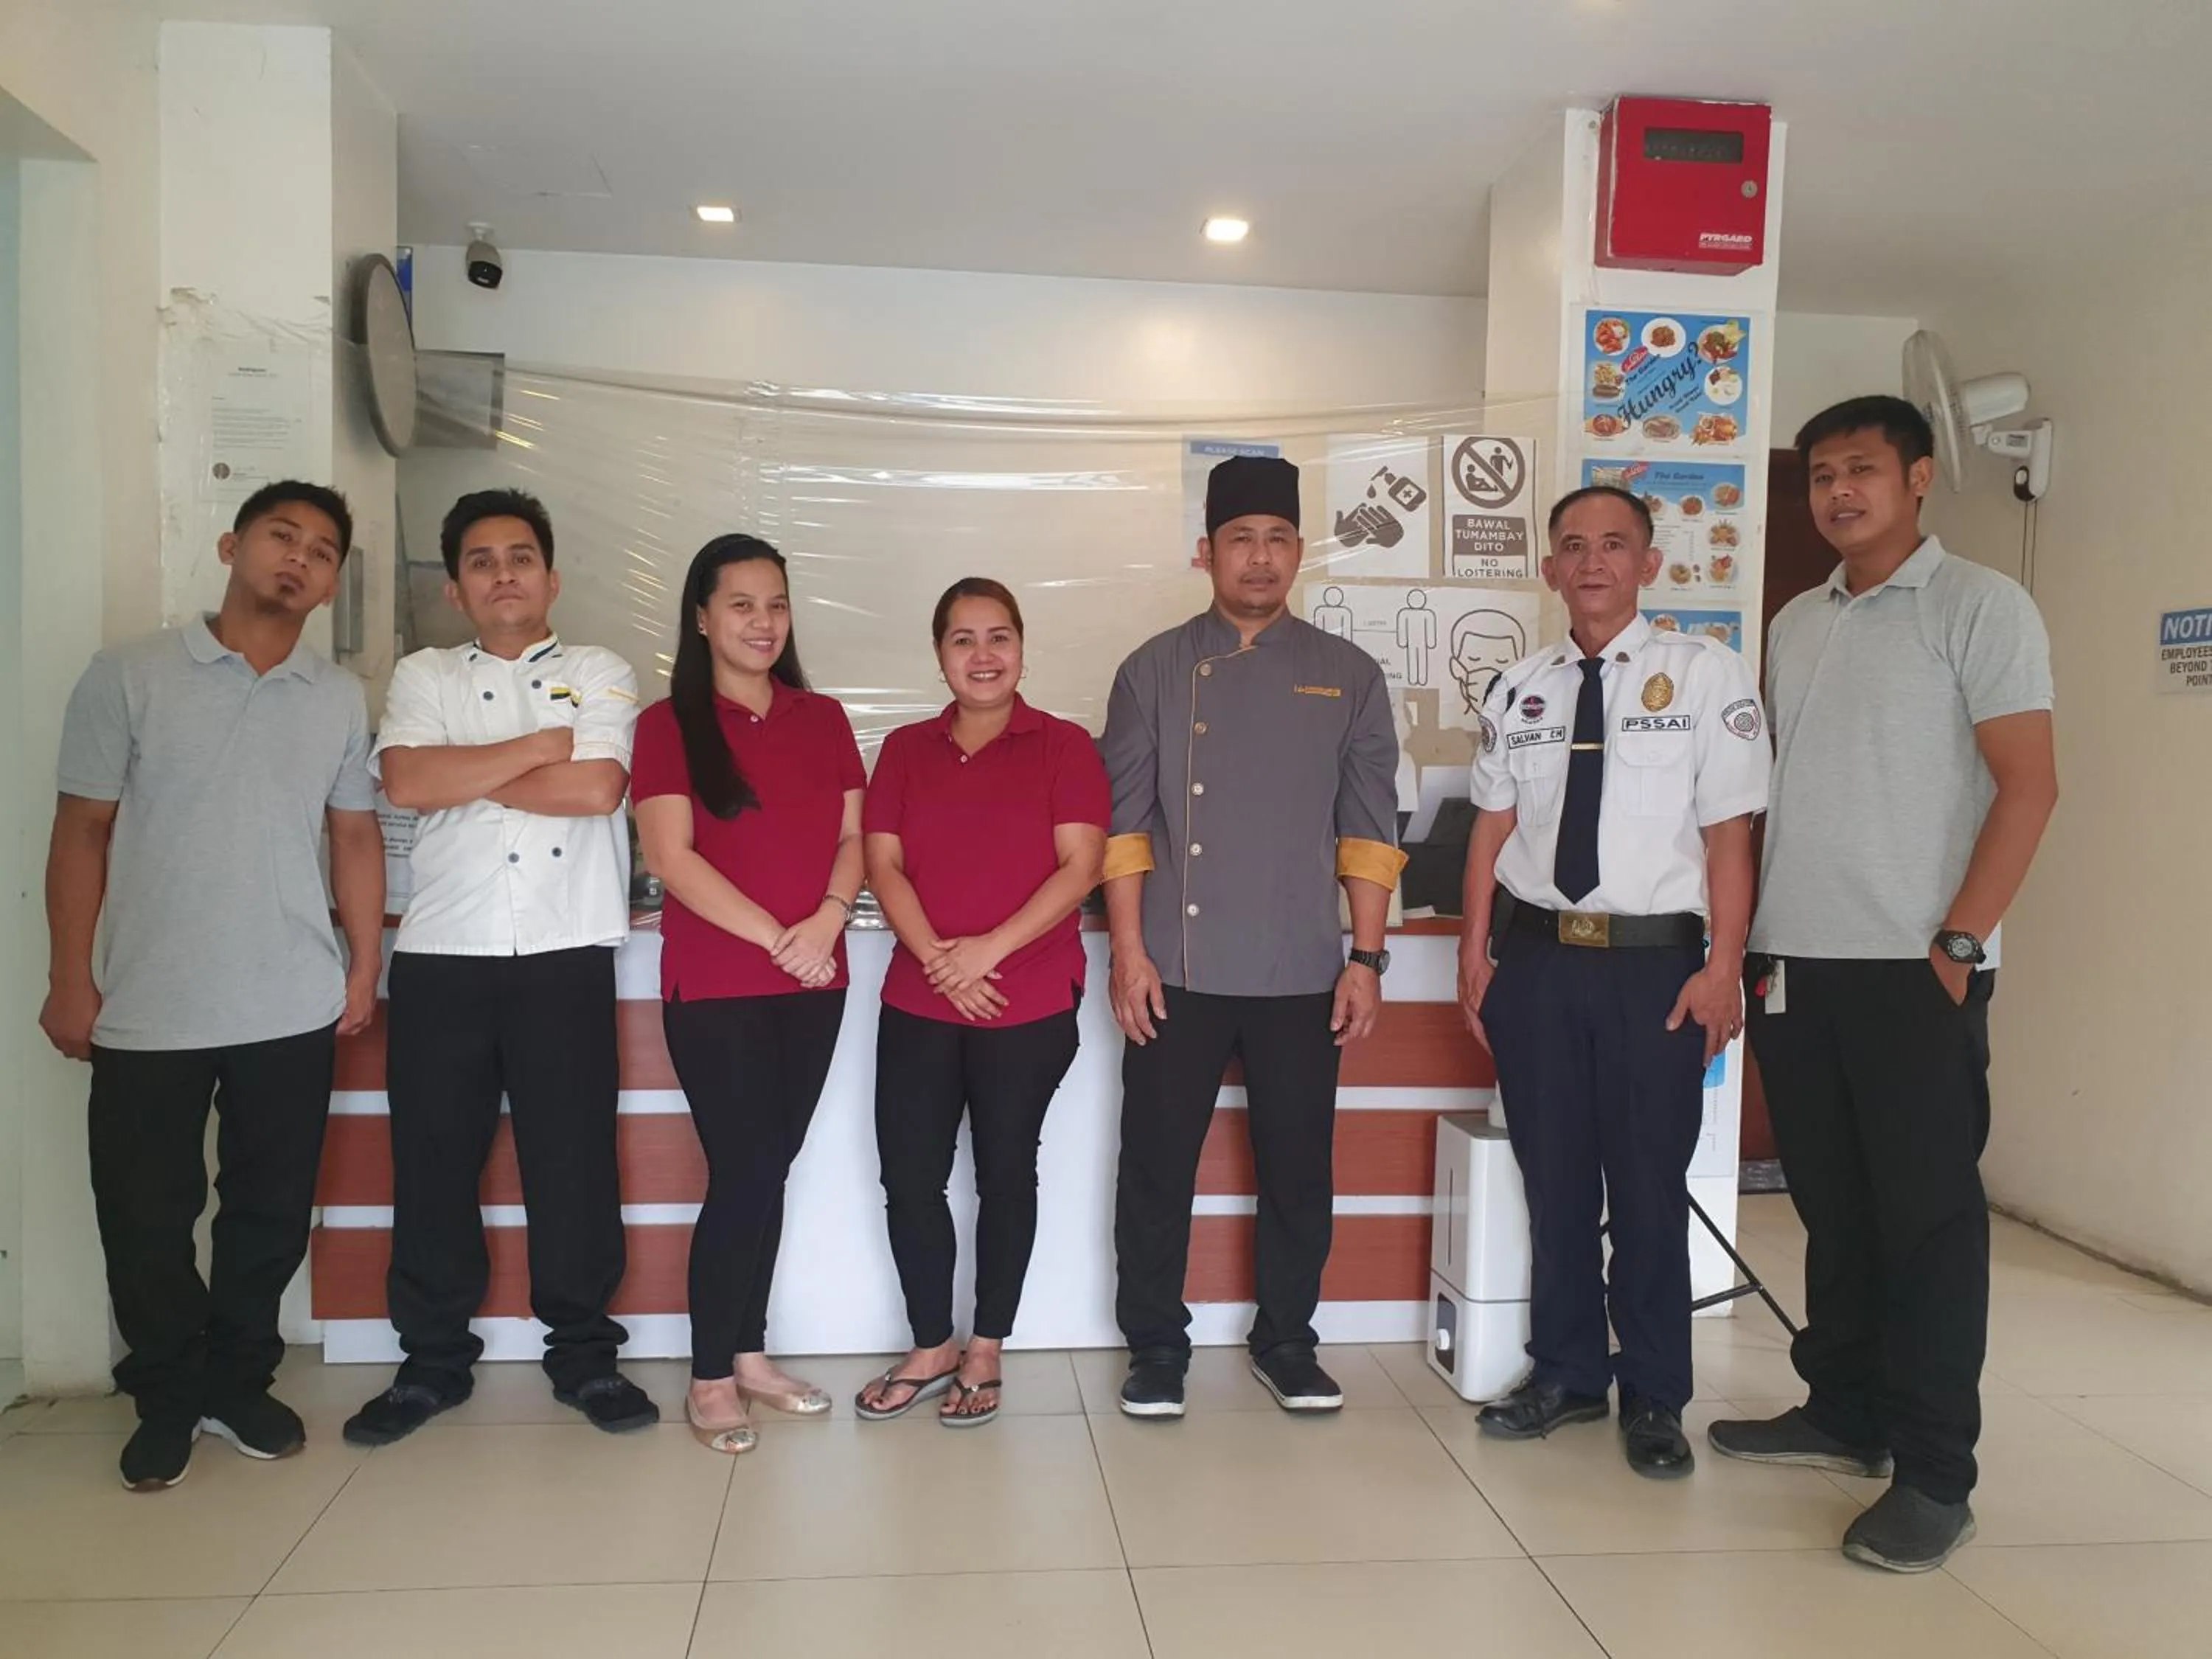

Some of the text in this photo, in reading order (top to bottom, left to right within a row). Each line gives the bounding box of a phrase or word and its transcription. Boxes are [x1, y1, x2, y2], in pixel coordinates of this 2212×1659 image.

[1617, 341, 1703, 429] Hungry?
[1467, 518, 1511, 530] BAWAL
[1455, 529, 1525, 540] TUMAMBAY
[1474, 542, 1504, 552] DITO
[1481, 558, 1499, 567] NO
[1458, 568, 1523, 578] LOITERING
[2170, 661, 2207, 674] BEYOND
[1626, 718, 1687, 729] PSSAI
